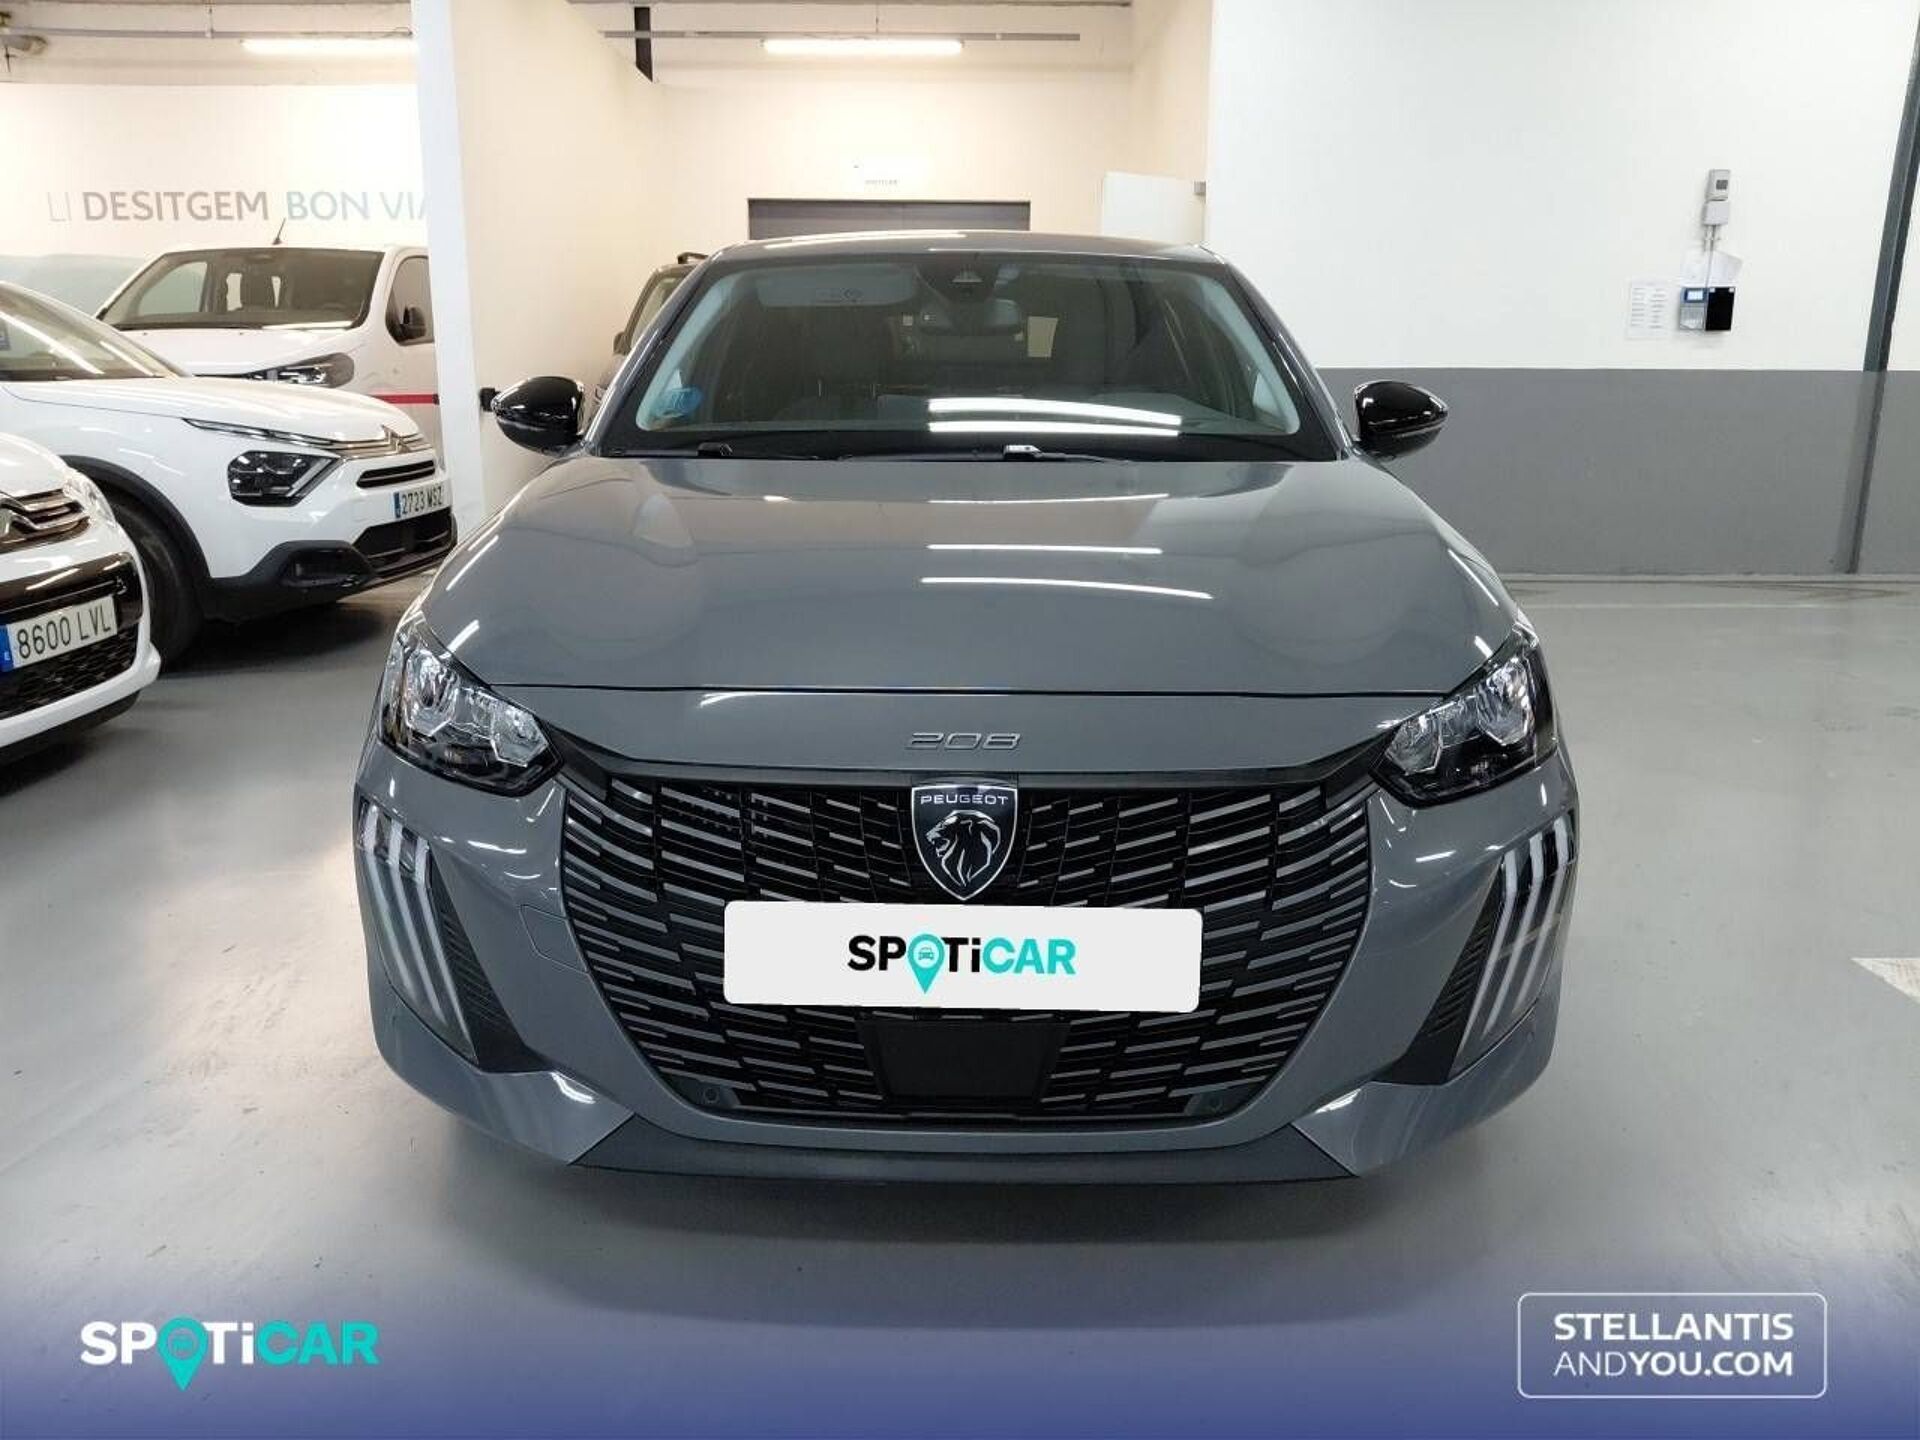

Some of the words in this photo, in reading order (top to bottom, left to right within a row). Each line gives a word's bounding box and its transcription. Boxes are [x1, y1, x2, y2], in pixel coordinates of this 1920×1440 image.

[82, 190, 269, 221] DESITGEM
[286, 190, 369, 221] BON
[402, 491, 425, 514] 2723
[17, 616, 71, 659] 8600
[77, 604, 111, 640] LVL
[907, 732, 1021, 750] 208
[920, 794, 1009, 806] PEUGEOT
